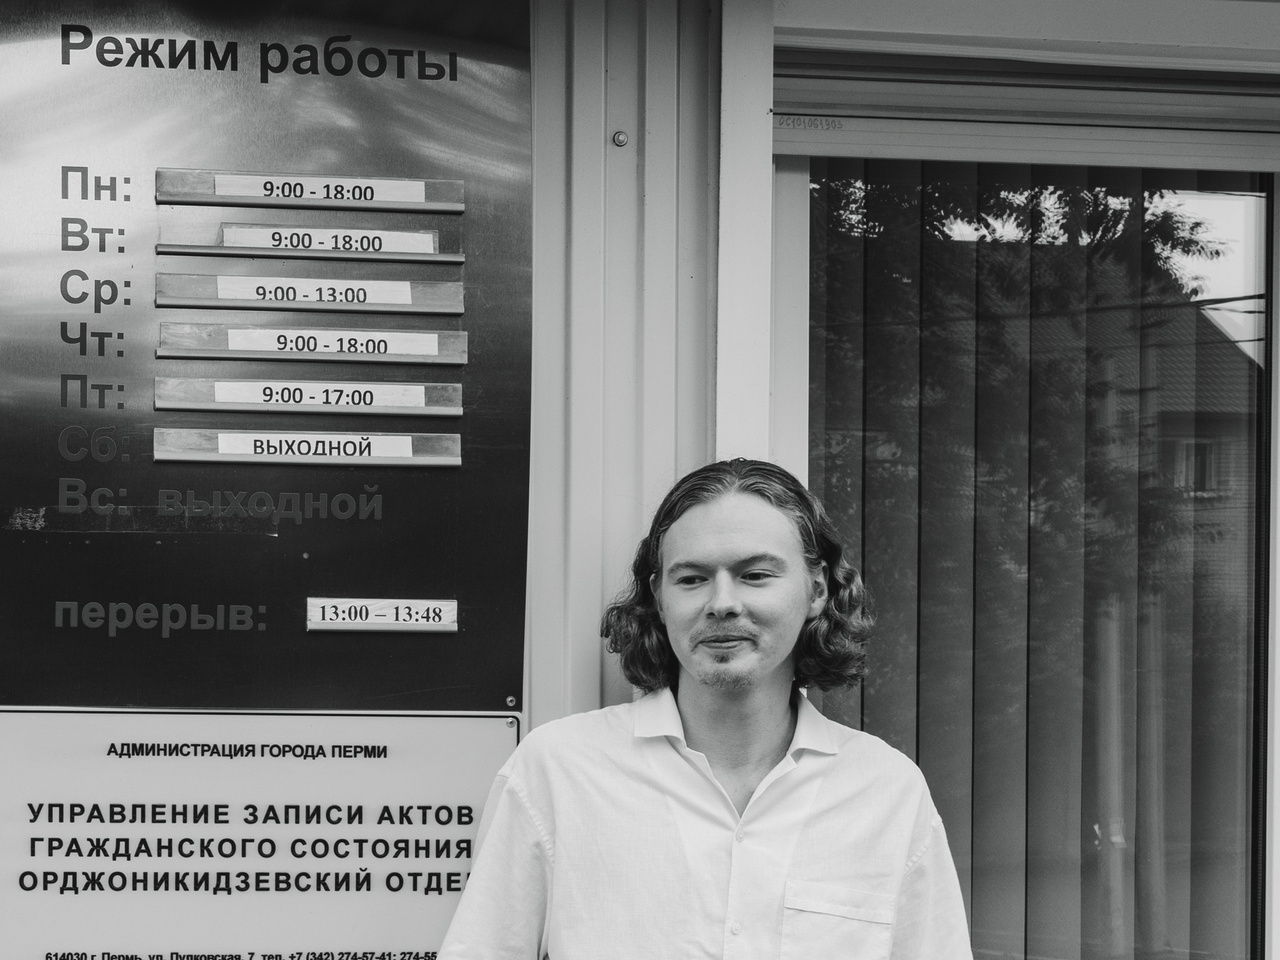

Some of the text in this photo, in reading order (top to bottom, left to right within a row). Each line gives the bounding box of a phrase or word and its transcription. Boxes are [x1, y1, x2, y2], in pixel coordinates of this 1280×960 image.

[60, 24, 459, 83] Режим работы
[61, 166, 132, 202] Пн:
[262, 180, 304, 198] 9:00
[322, 184, 375, 201] 18:00
[61, 218, 125, 253] Вт:
[271, 231, 313, 249] 9:00
[331, 234, 383, 252] 18:00
[60, 270, 132, 313] Ср:
[255, 285, 297, 302] 9:00
[315, 287, 367, 304] 13:00
[60, 322, 125, 358] Чт:
[276, 334, 318, 352] 9:00
[335, 337, 388, 355] 18:00
[61, 374, 125, 410] Пт:
[262, 387, 304, 404] 9:00
[321, 389, 374, 406] 17:00
[58, 425, 373, 462] Сб: ВЫХОДНОЙ
[58, 478, 383, 524] Вс: выходной
[54, 600, 267, 637] перерыв:
[318, 604, 370, 622] 13:00
[392, 605, 443, 625] 13:48
[107, 742, 388, 761] АДМИНИСТРАЦИЯ ГОРОДА ПЕРМИ
[27, 803, 474, 826] УПРАВЛЕНИЕ ЗАПИСИ АКТОВ
[30, 837, 472, 862] ГРАЖДАНСКОГО СОСТОЯНИЯ
[18, 868, 471, 895] ОРДЖОНИКИДЗЕВСКИЙ ОТДЕ
